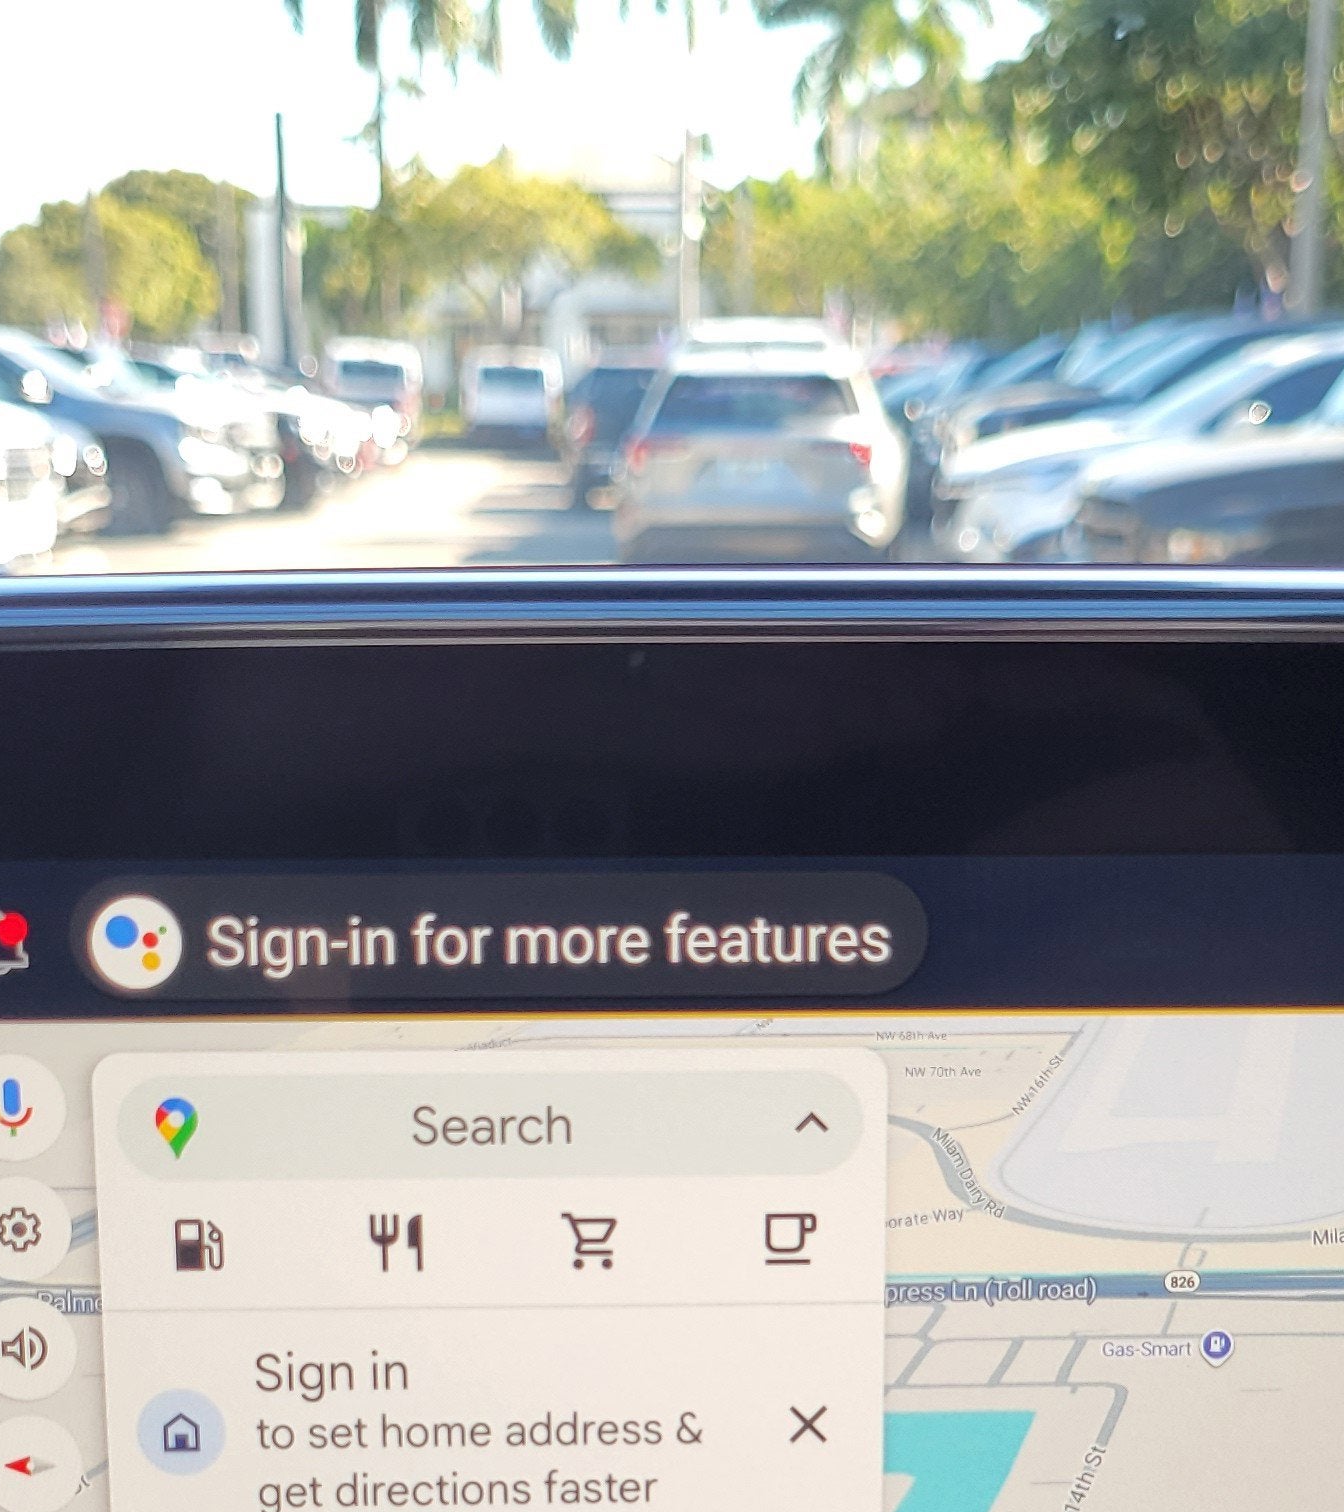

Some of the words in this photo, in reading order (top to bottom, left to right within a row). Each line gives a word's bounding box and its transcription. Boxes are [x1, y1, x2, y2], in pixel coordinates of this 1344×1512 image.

[206, 914, 396, 979] Sign-in
[412, 912, 492, 967] for
[506, 923, 650, 966] more
[665, 911, 894, 965] features
[876, 1031, 897, 1042] NW
[925, 1030, 948, 1041] Ave
[905, 1067, 926, 1078] NW
[929, 1066, 956, 1078] 70th
[960, 1066, 982, 1077] Ave
[1012, 1093, 1032, 1116] NW
[1048, 1053, 1064, 1072] St
[411, 1103, 573, 1146] Search
[932, 1127, 966, 1168] Milam
[959, 1167, 986, 1204] Dairy
[984, 1199, 1005, 1219] Rd
[933, 1207, 964, 1223] Way
[951, 1280, 978, 1302] Ln
[984, 1276, 1033, 1307] (Toll
[1037, 1275, 1097, 1306] road)
[1170, 1275, 1195, 1289] 826
[1102, 1341, 1192, 1358] Gas-Smart
[256, 1353, 355, 1403] Sign
[371, 1352, 409, 1392] in
[257, 1418, 295, 1451] to
[308, 1417, 369, 1449] set
[382, 1413, 491, 1448] home
[506, 1411, 663, 1447] address
[677, 1413, 704, 1445] &
[336, 1471, 531, 1508] directions
[544, 1470, 659, 1506] faster
[1064, 1471, 1095, 1512] 14th
[1085, 1445, 1107, 1467] St
